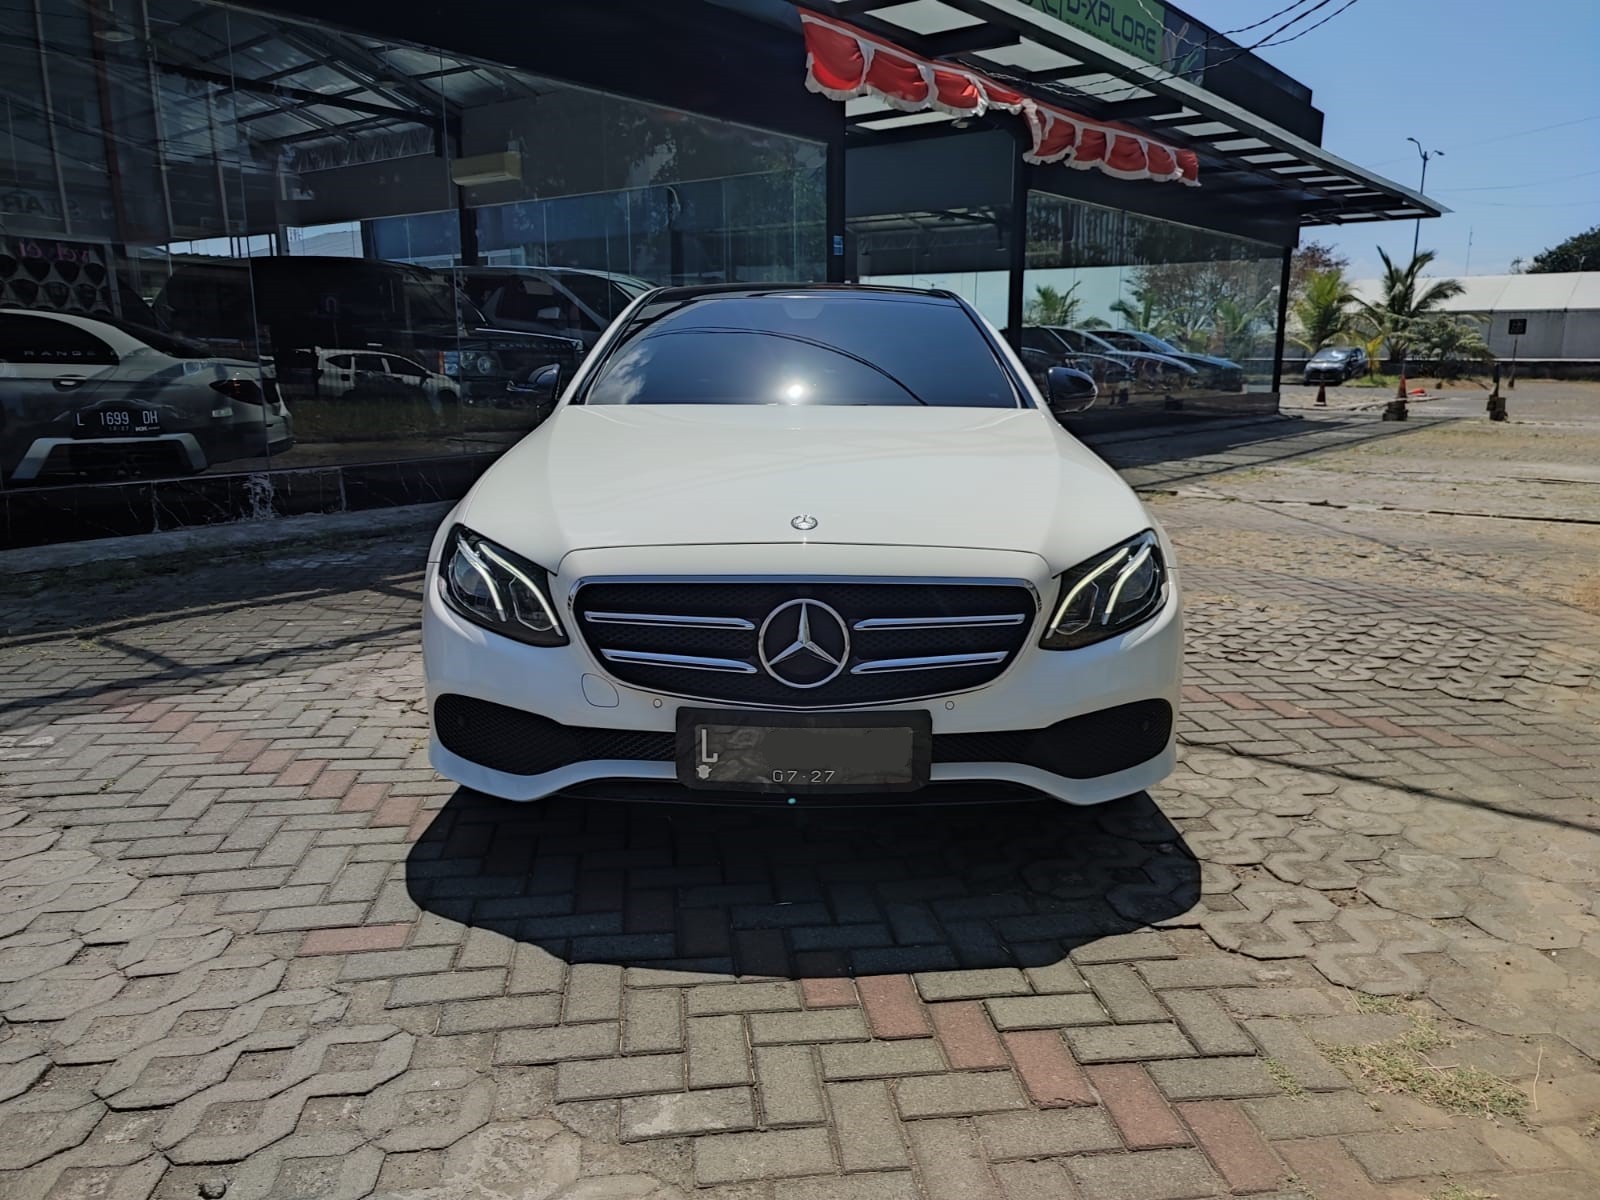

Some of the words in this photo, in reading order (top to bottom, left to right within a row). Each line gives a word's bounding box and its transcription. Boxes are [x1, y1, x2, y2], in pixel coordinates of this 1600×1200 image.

[76, 412, 86, 426] L
[100, 411, 130, 425] 1699
[701, 728, 719, 763] L
